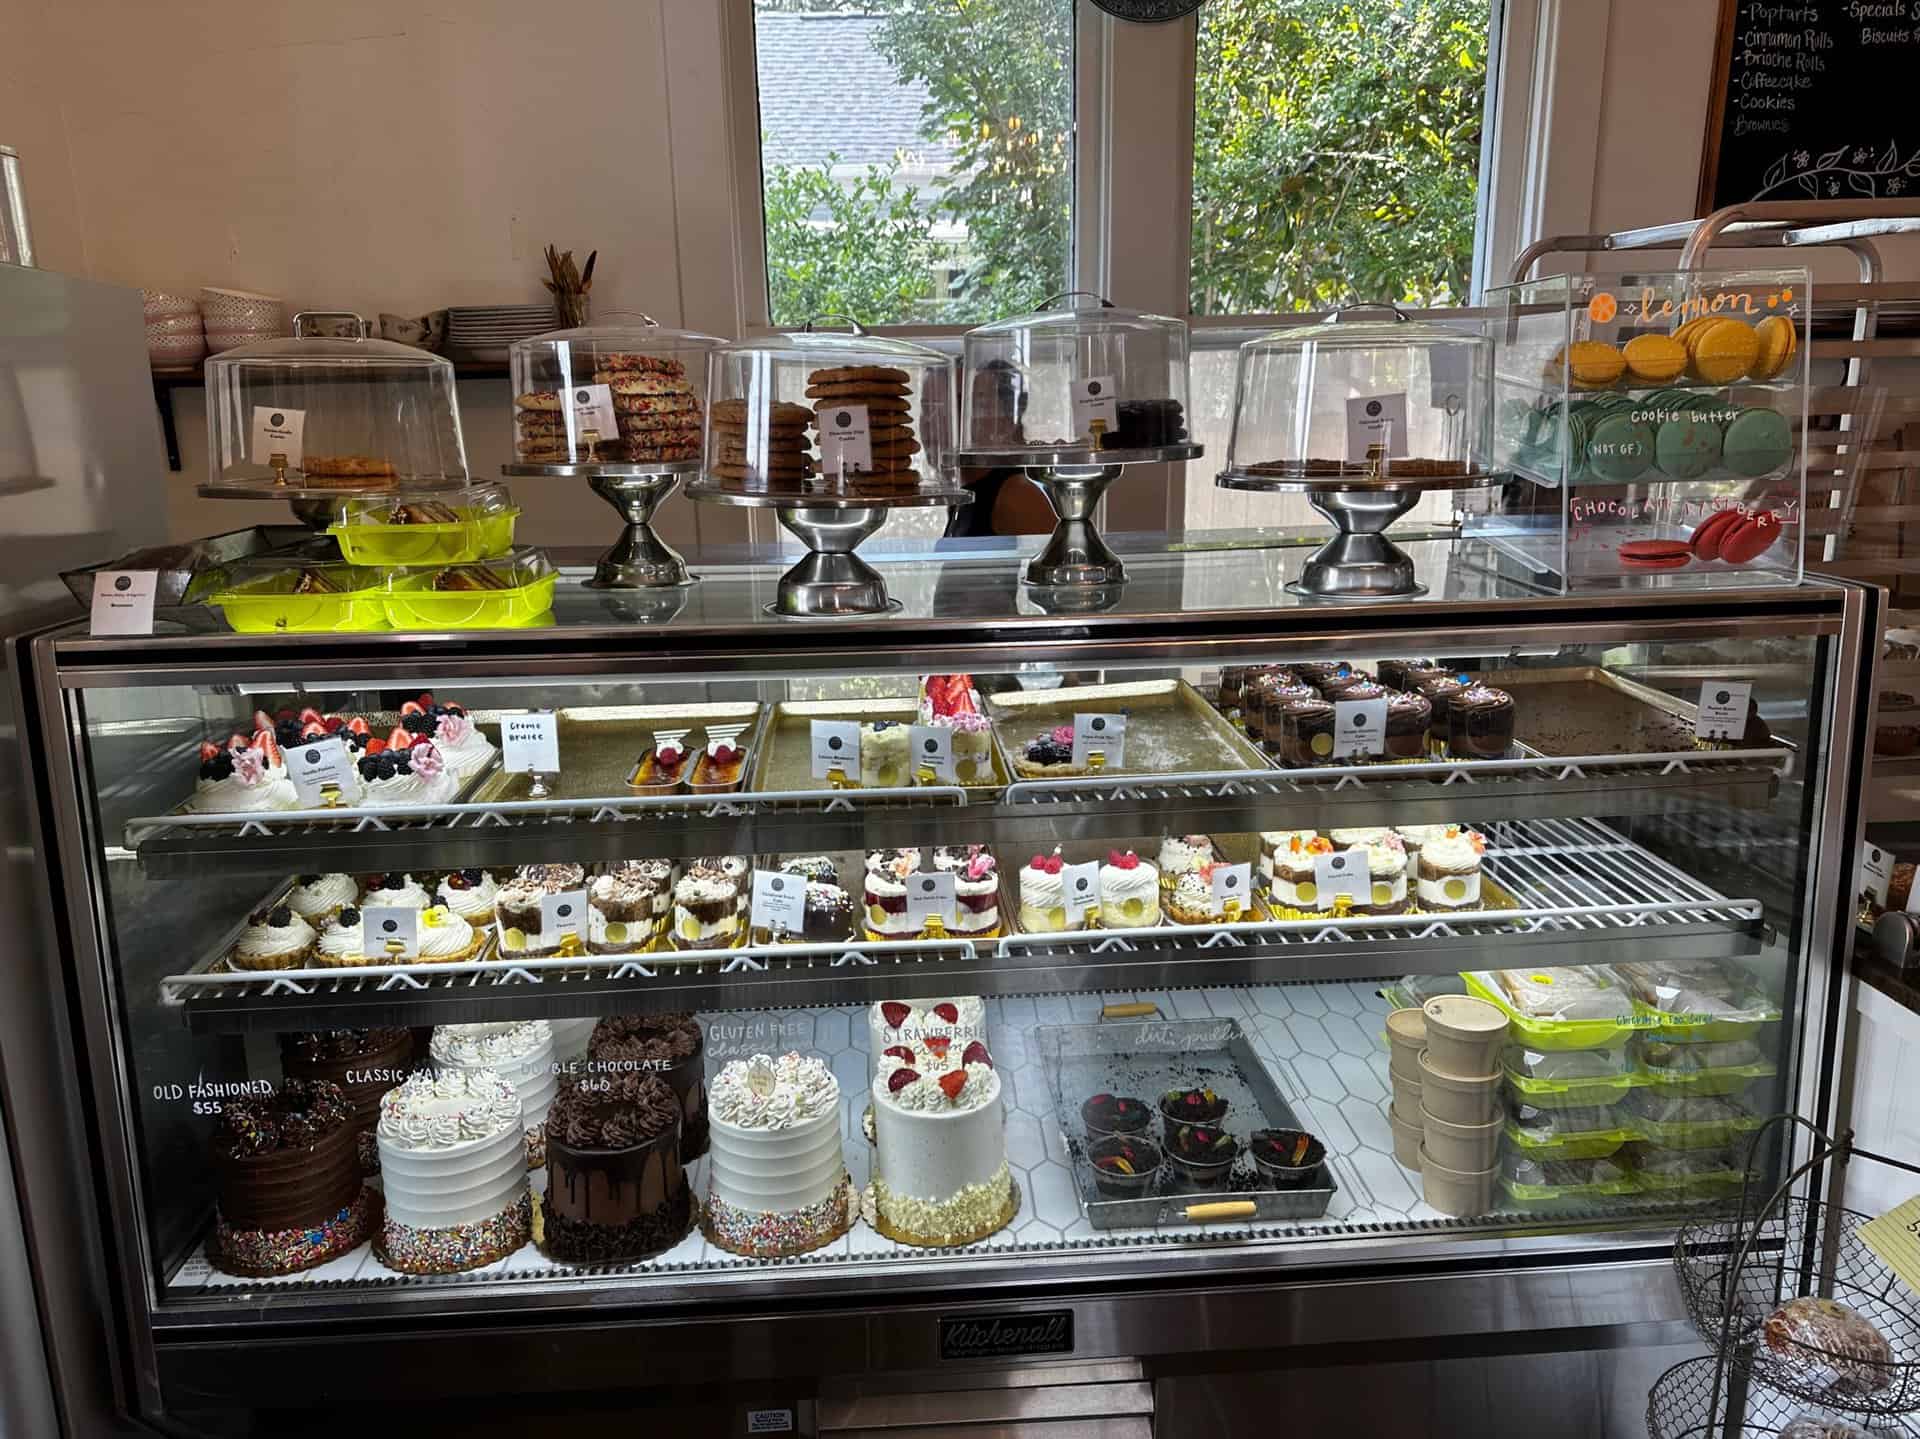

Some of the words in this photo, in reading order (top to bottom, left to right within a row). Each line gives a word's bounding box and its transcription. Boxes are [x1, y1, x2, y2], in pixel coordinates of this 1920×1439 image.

[1750, 2, 1818, 27] Poptarts
[1849, 0, 1905, 23] Specials
[1740, 92, 1796, 110] Cookies
[709, 1023, 765, 1041] GLUTEN
[587, 1059, 673, 1073] CHOCOLATE
[345, 1069, 404, 1083] CLASSIC
[153, 1084, 183, 1100] OLD
[188, 1079, 273, 1099] FASHIONED
[192, 1101, 223, 1115] $55
